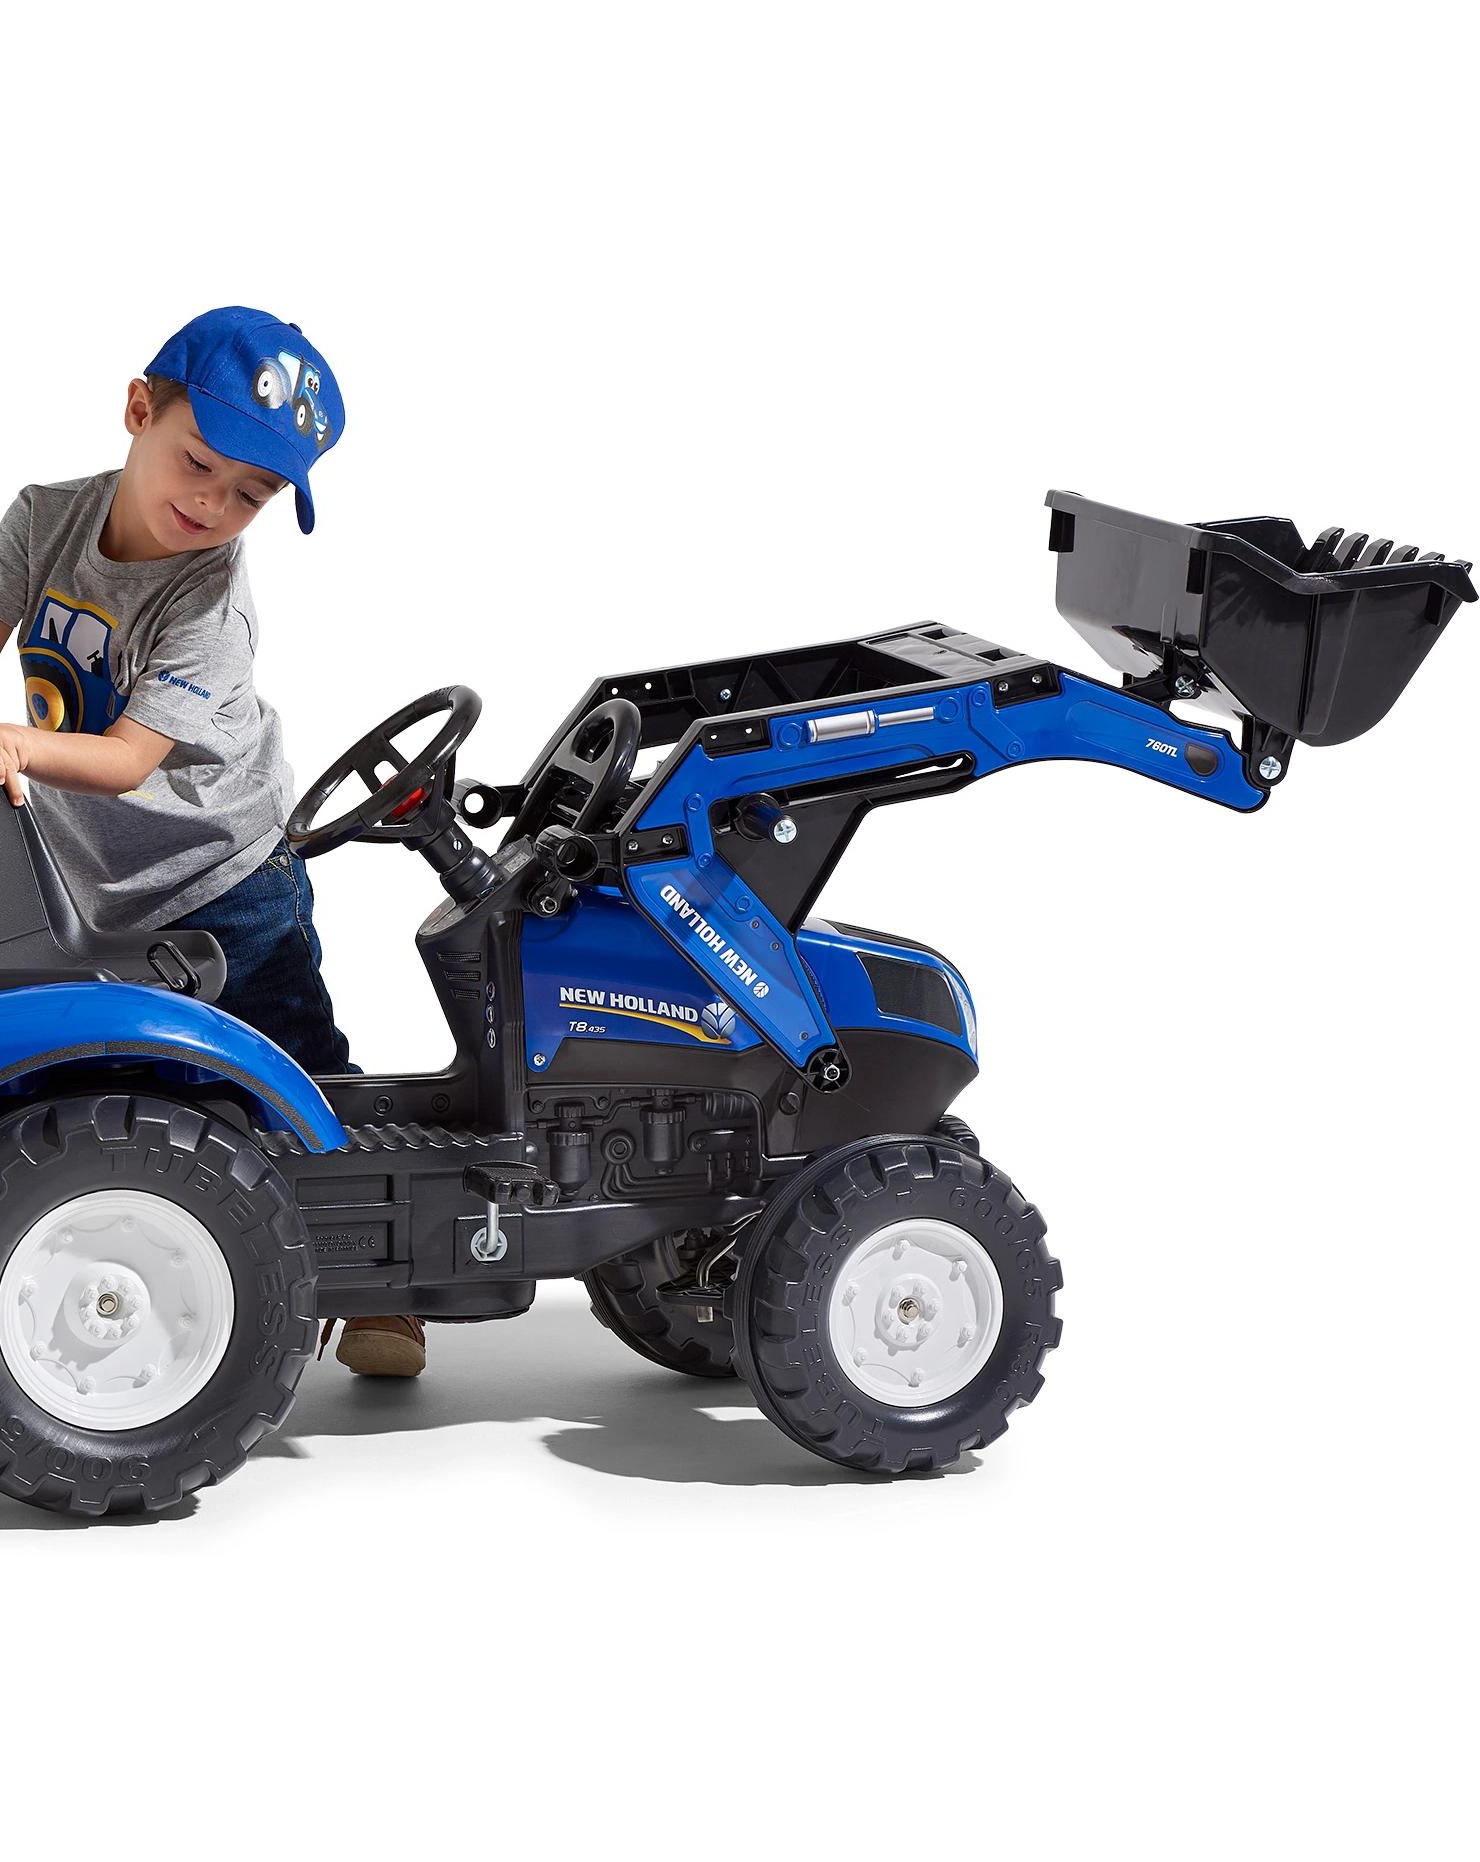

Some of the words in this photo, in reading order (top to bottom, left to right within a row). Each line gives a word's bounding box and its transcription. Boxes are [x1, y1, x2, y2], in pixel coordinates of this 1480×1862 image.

[1145, 738, 1178, 758] 760TL
[660, 884, 726, 954] HOLLAND
[719, 948, 758, 987] NEW
[559, 986, 605, 1005] NEW
[609, 992, 698, 1023] HOLLAND
[100, 1145, 288, 1378] TUBELESS
